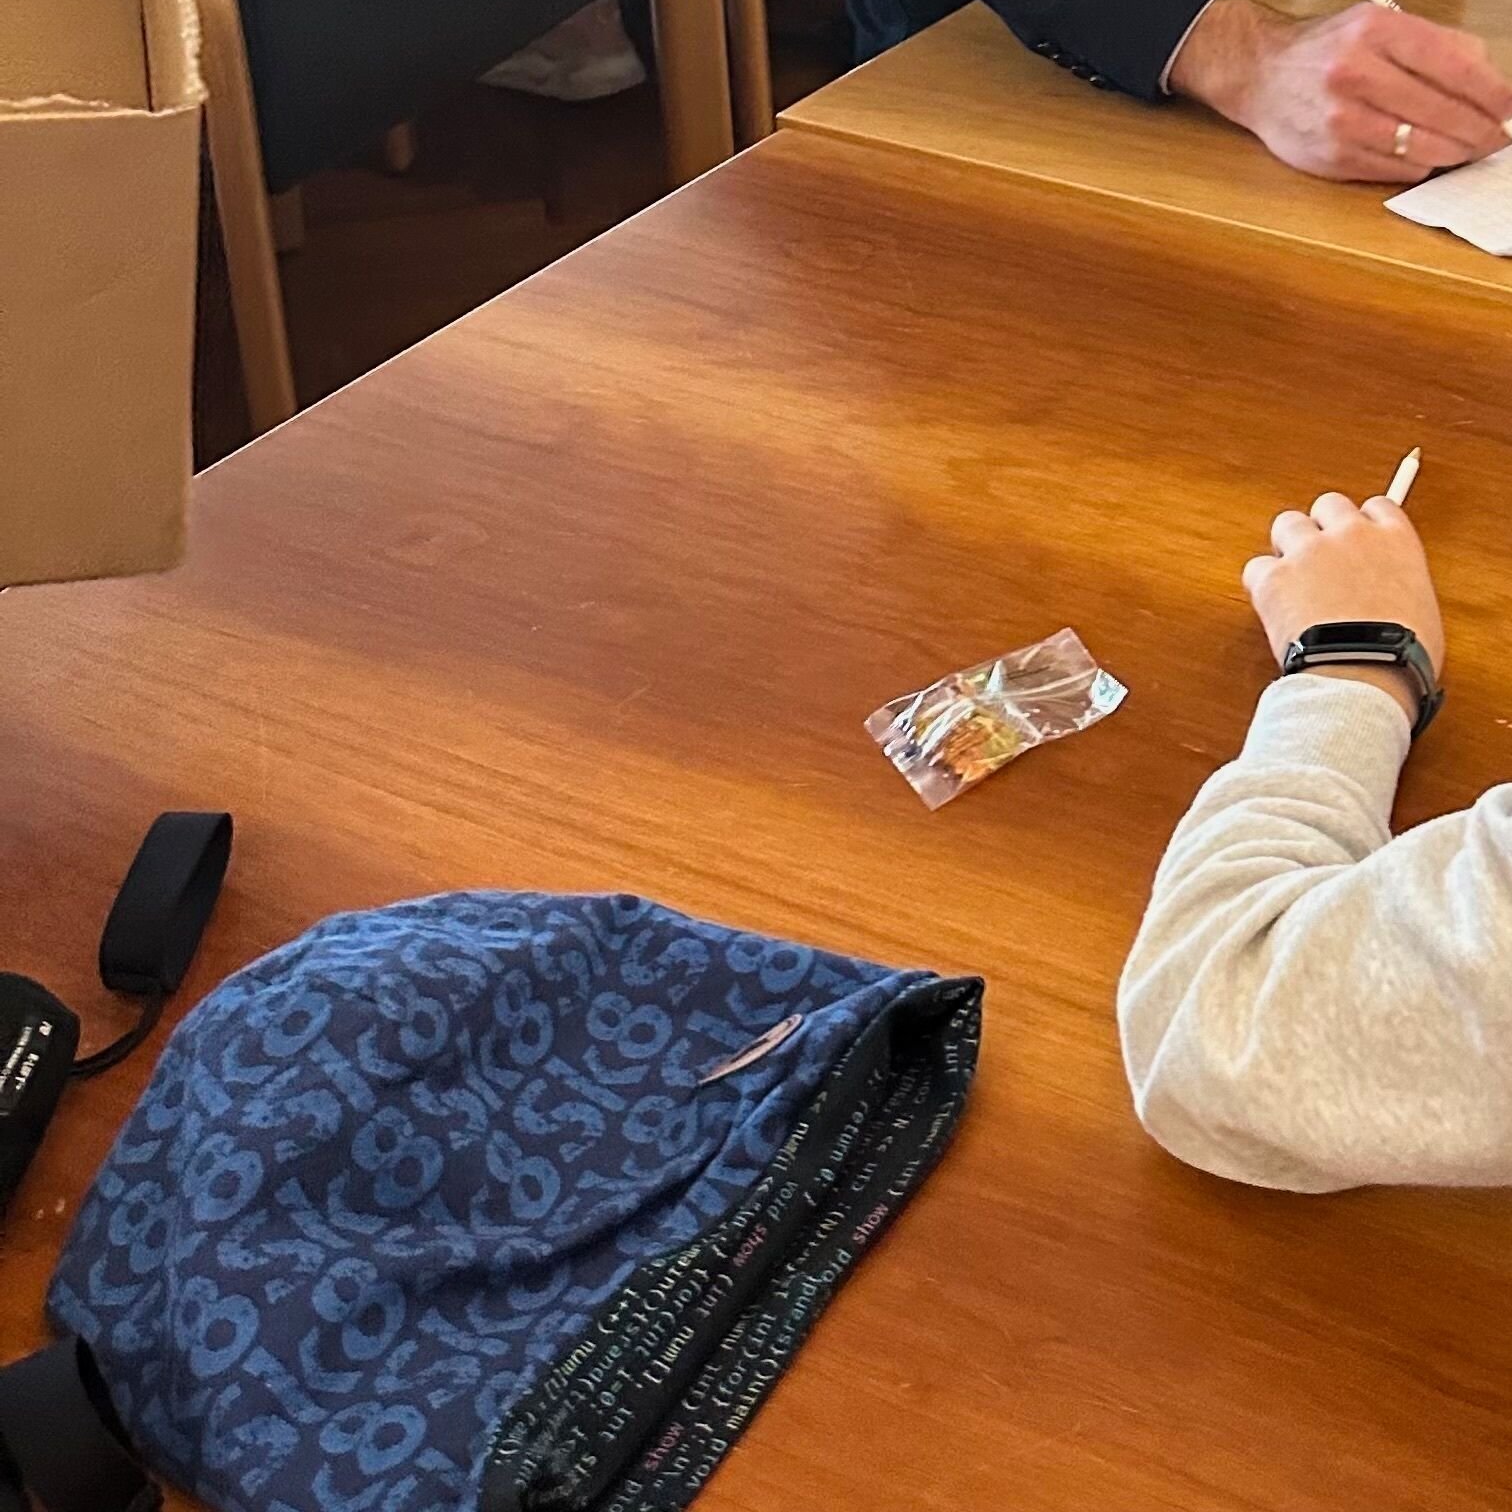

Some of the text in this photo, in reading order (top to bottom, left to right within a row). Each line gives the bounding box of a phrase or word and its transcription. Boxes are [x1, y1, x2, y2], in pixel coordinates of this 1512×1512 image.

[238, 971, 450, 1163] Sk8
[411, 968, 563, 1148] Sk8
[515, 988, 669, 1162] Sk8
[828, 1098, 869, 1164] return
[216, 1107, 443, 1303] Sk8
[765, 1181, 799, 1222] void
[852, 1162, 878, 1192] cin
[731, 1222, 767, 1268] show
[820, 1246, 852, 1282] oid
[855, 1201, 889, 1245] show
[596, 1289, 639, 1333] i++)
[635, 1269, 708, 1355] {for(int
[693, 1274, 733, 1321] (int
[202, 1257, 407, 1494] Sk8
[712, 1311, 775, 1407] {for(int
[599, 1408, 634, 1441] int
[643, 1420, 684, 1471] show
[682, 1362, 721, 1408] (int
[685, 1438, 728, 1487] void
